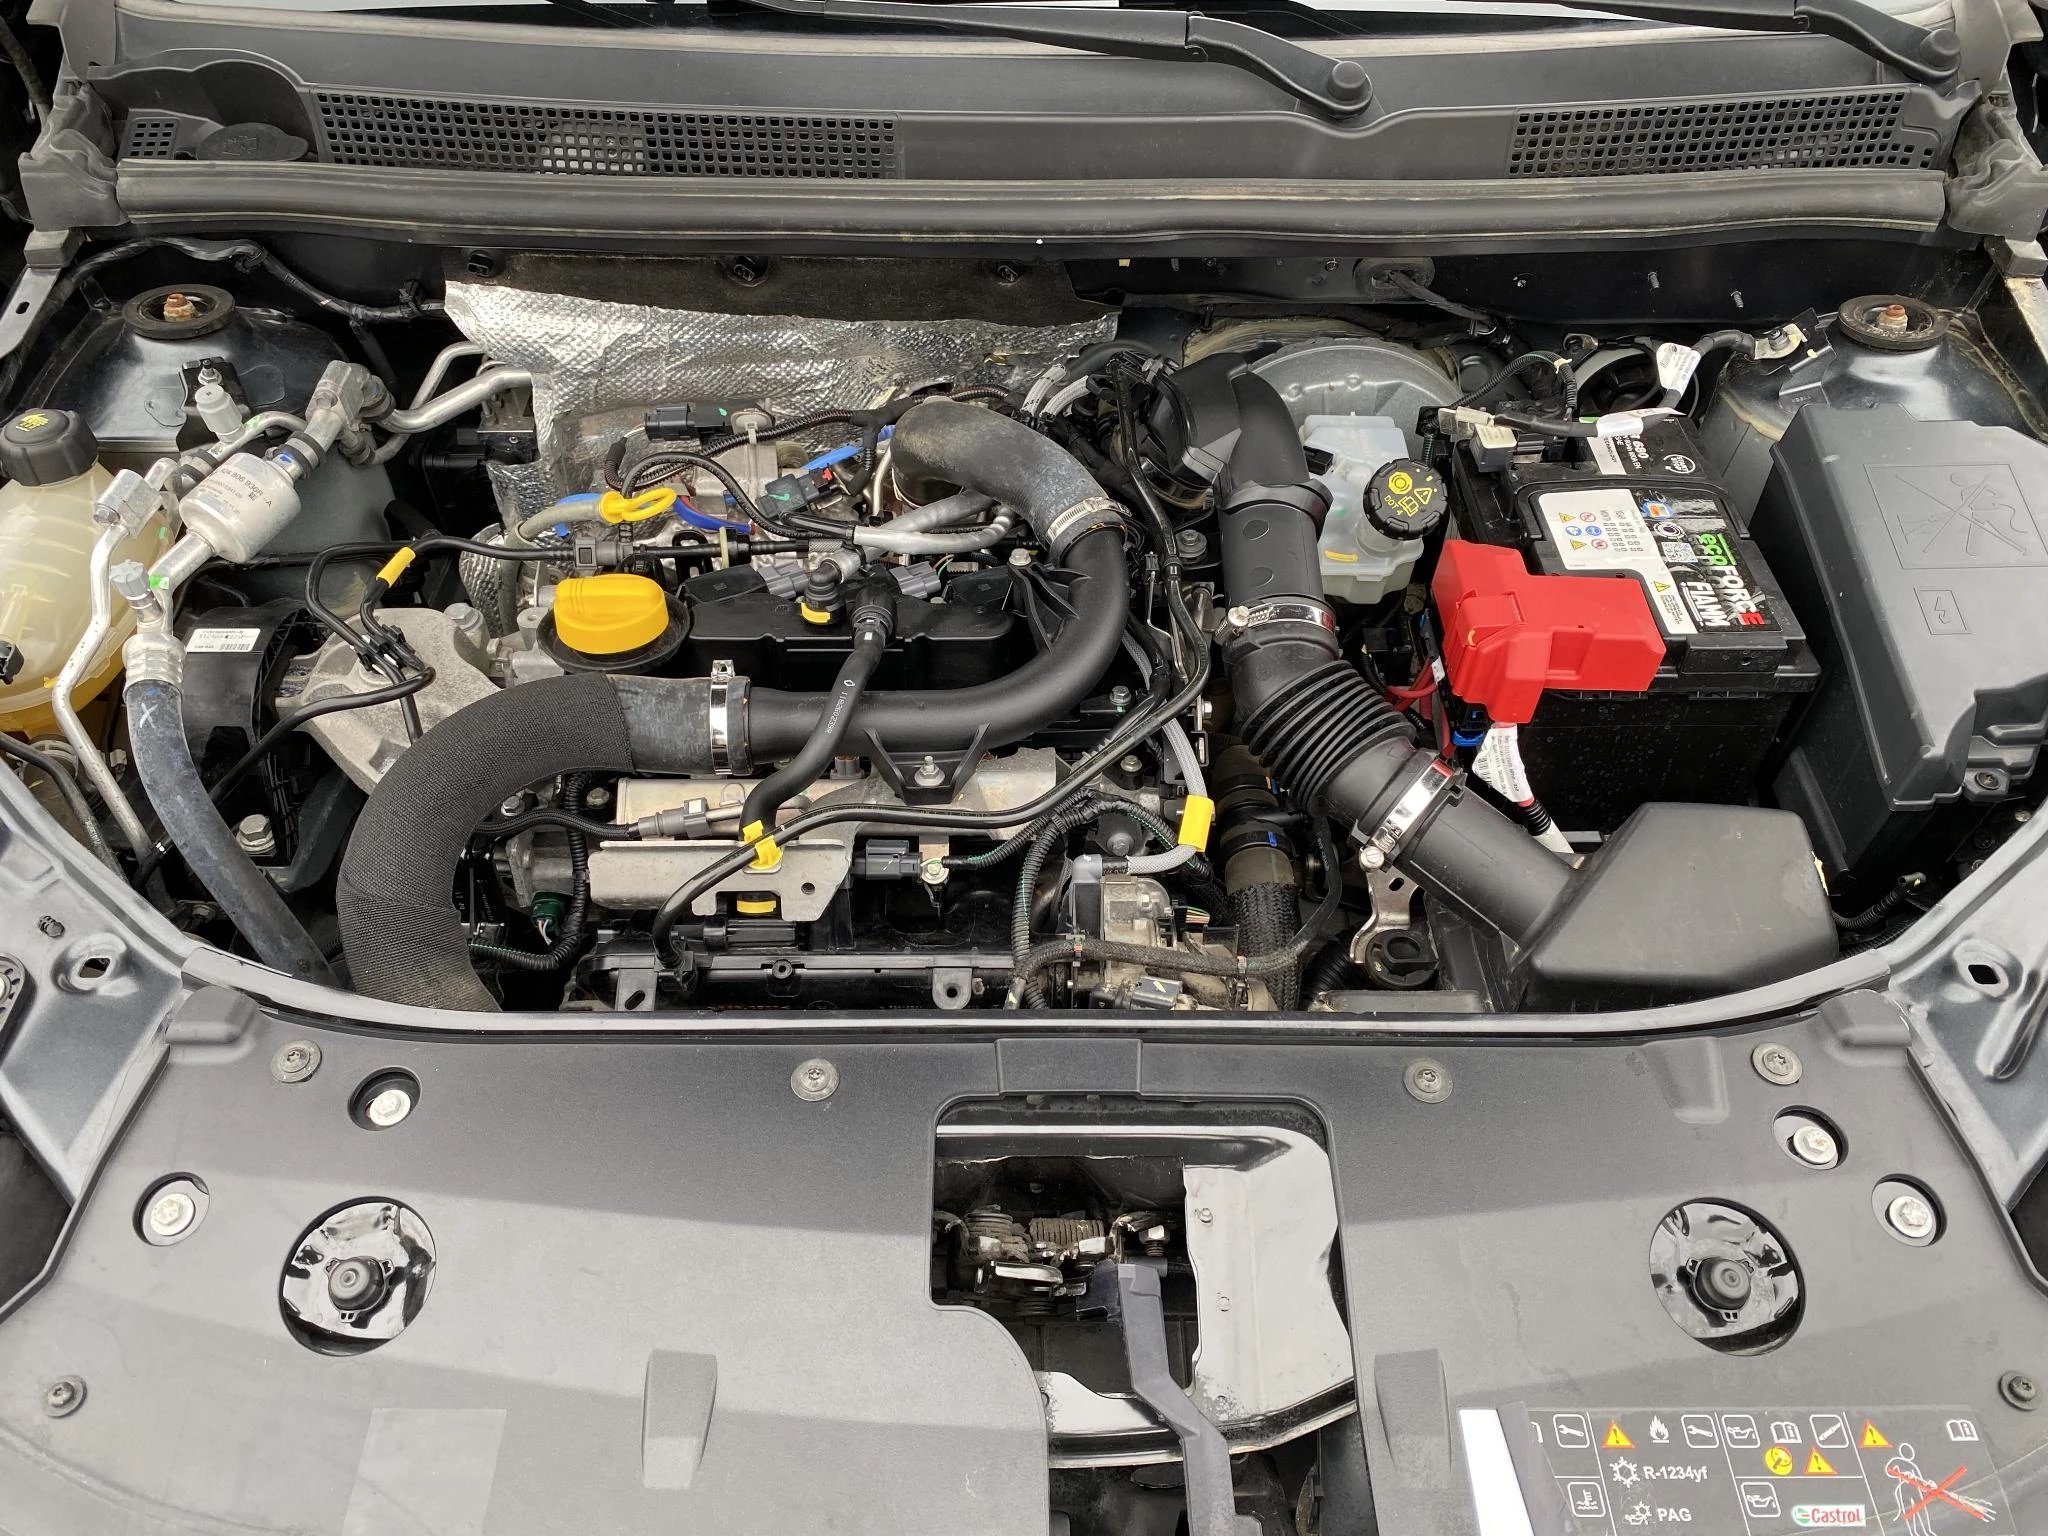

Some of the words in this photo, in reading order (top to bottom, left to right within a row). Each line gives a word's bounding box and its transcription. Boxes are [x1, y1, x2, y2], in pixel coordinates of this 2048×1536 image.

[1632, 440, 1649, 459] 680
[1384, 494, 1399, 510] DOT
[1686, 581, 1731, 626] FIAMM
[1643, 1465, 1708, 1482] R-1234yf
[1657, 1508, 1693, 1522] PAG
[1811, 1507, 1862, 1524] Castrol
